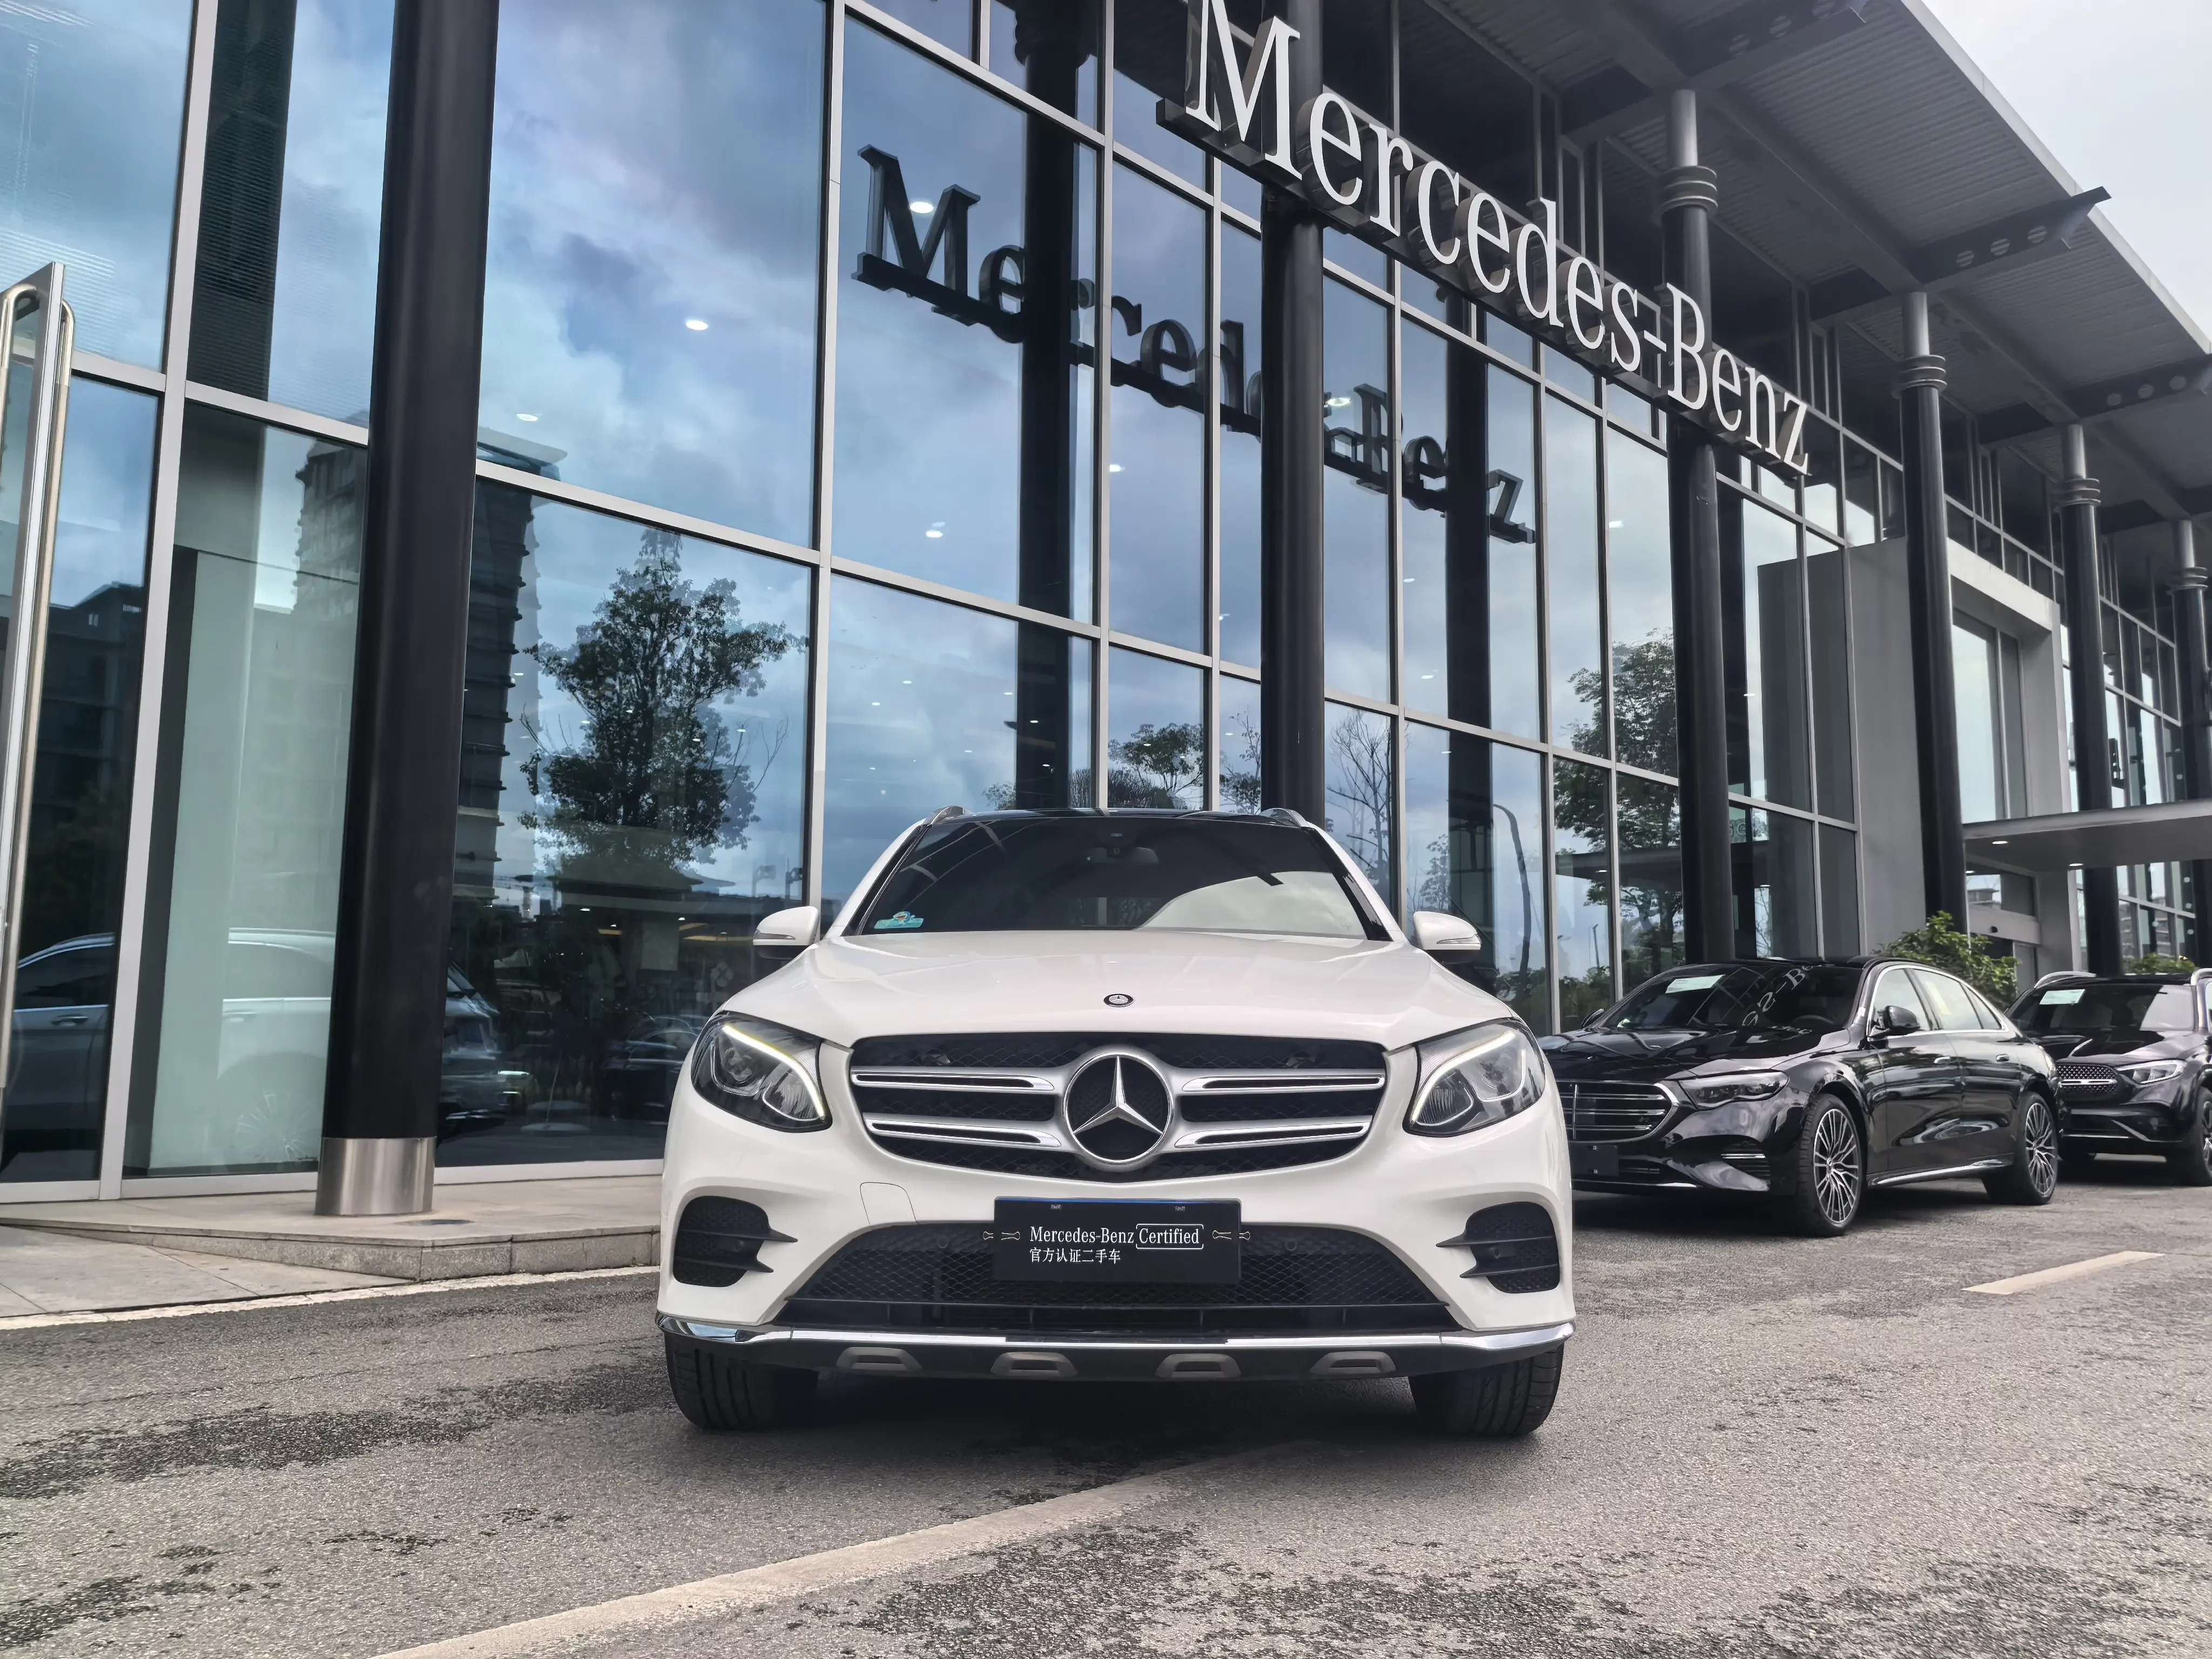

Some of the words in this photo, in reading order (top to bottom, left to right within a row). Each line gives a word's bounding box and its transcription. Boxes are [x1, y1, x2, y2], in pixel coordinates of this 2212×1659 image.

[1185, 0, 1809, 475] Mercedes-Benz
[1029, 1226, 1134, 1244] Mercedes-Benz
[1138, 1228, 1200, 1244] Certified
[1029, 1247, 1121, 1264] 官方认证二手车
